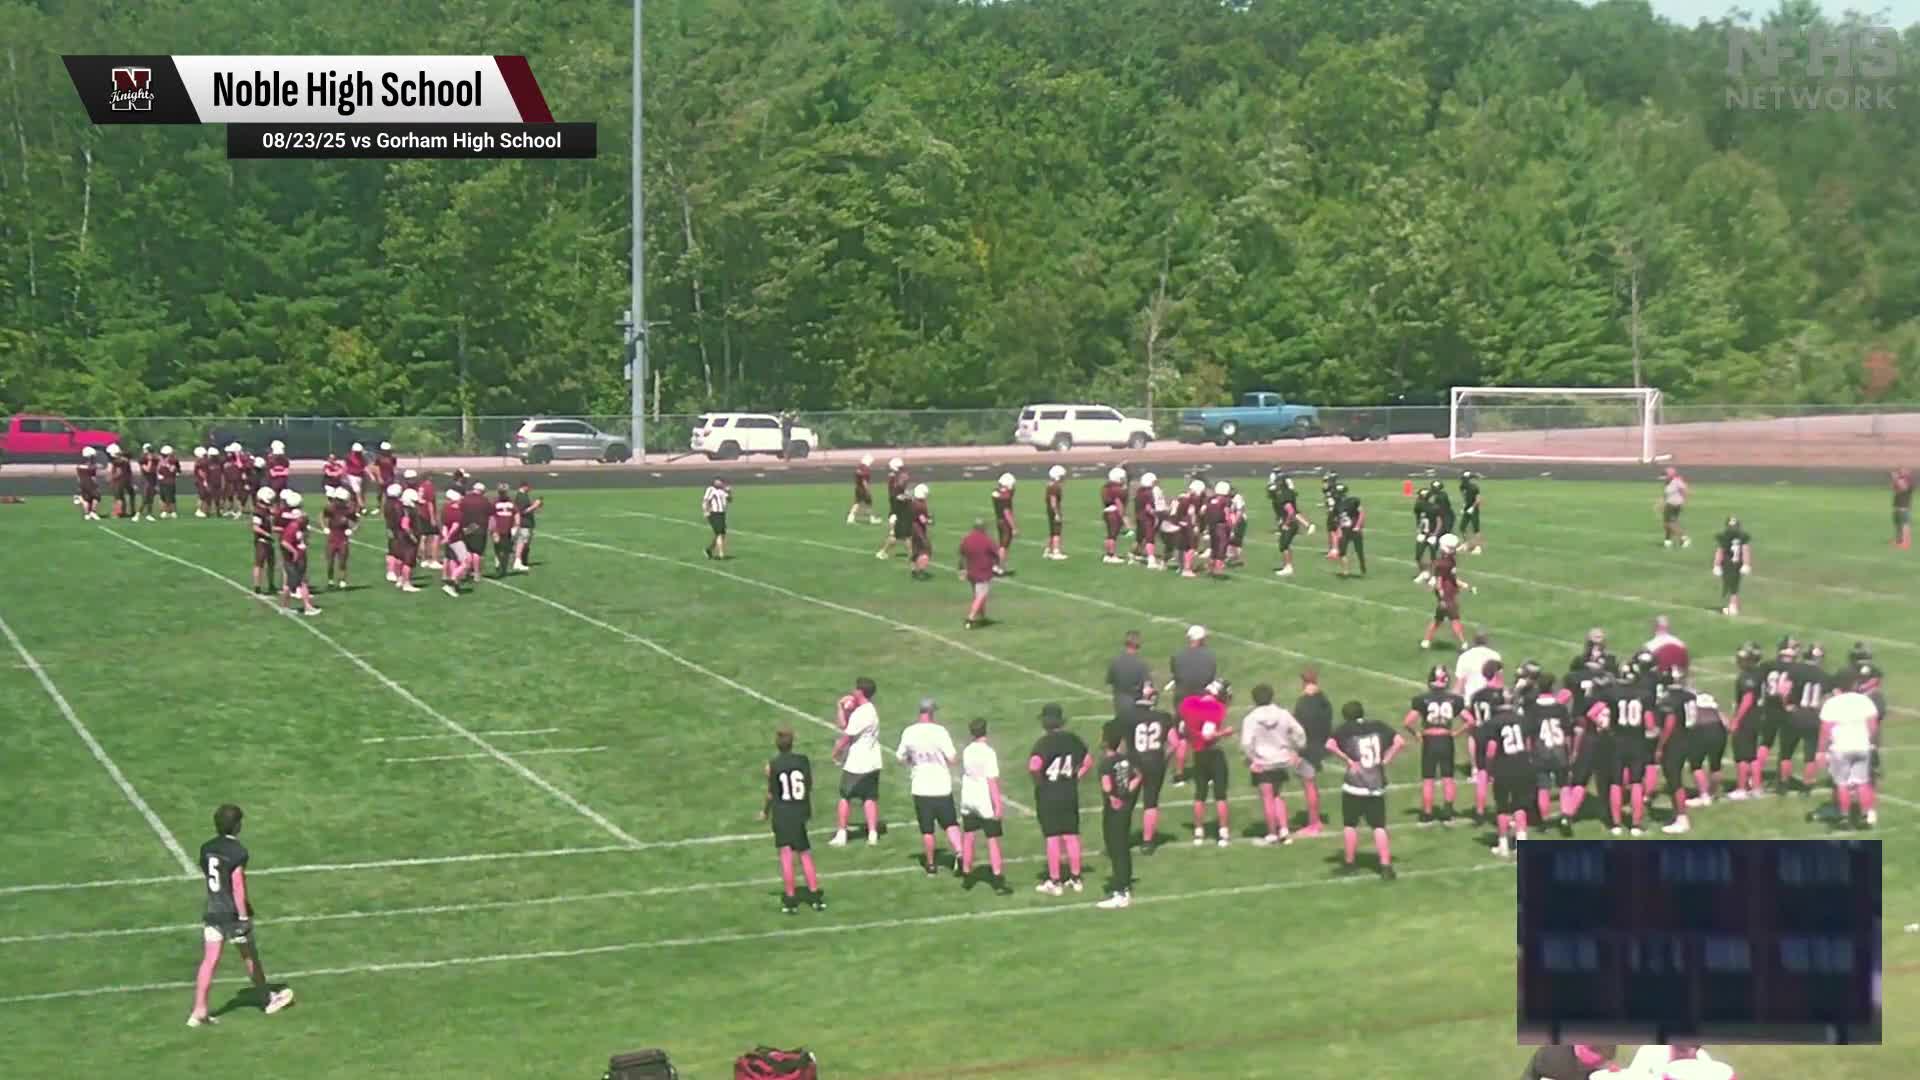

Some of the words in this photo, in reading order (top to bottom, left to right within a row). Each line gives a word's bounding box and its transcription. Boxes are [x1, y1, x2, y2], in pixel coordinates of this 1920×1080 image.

[1616, 699, 1643, 726] 10
[1134, 721, 1162, 752] 62
[1501, 723, 1525, 754] 21
[1539, 718, 1564, 748] 45
[1359, 736, 1382, 767] 51
[1045, 755, 1073, 782] 44
[778, 770, 805, 801] 16
[207, 856, 220, 892] 5
